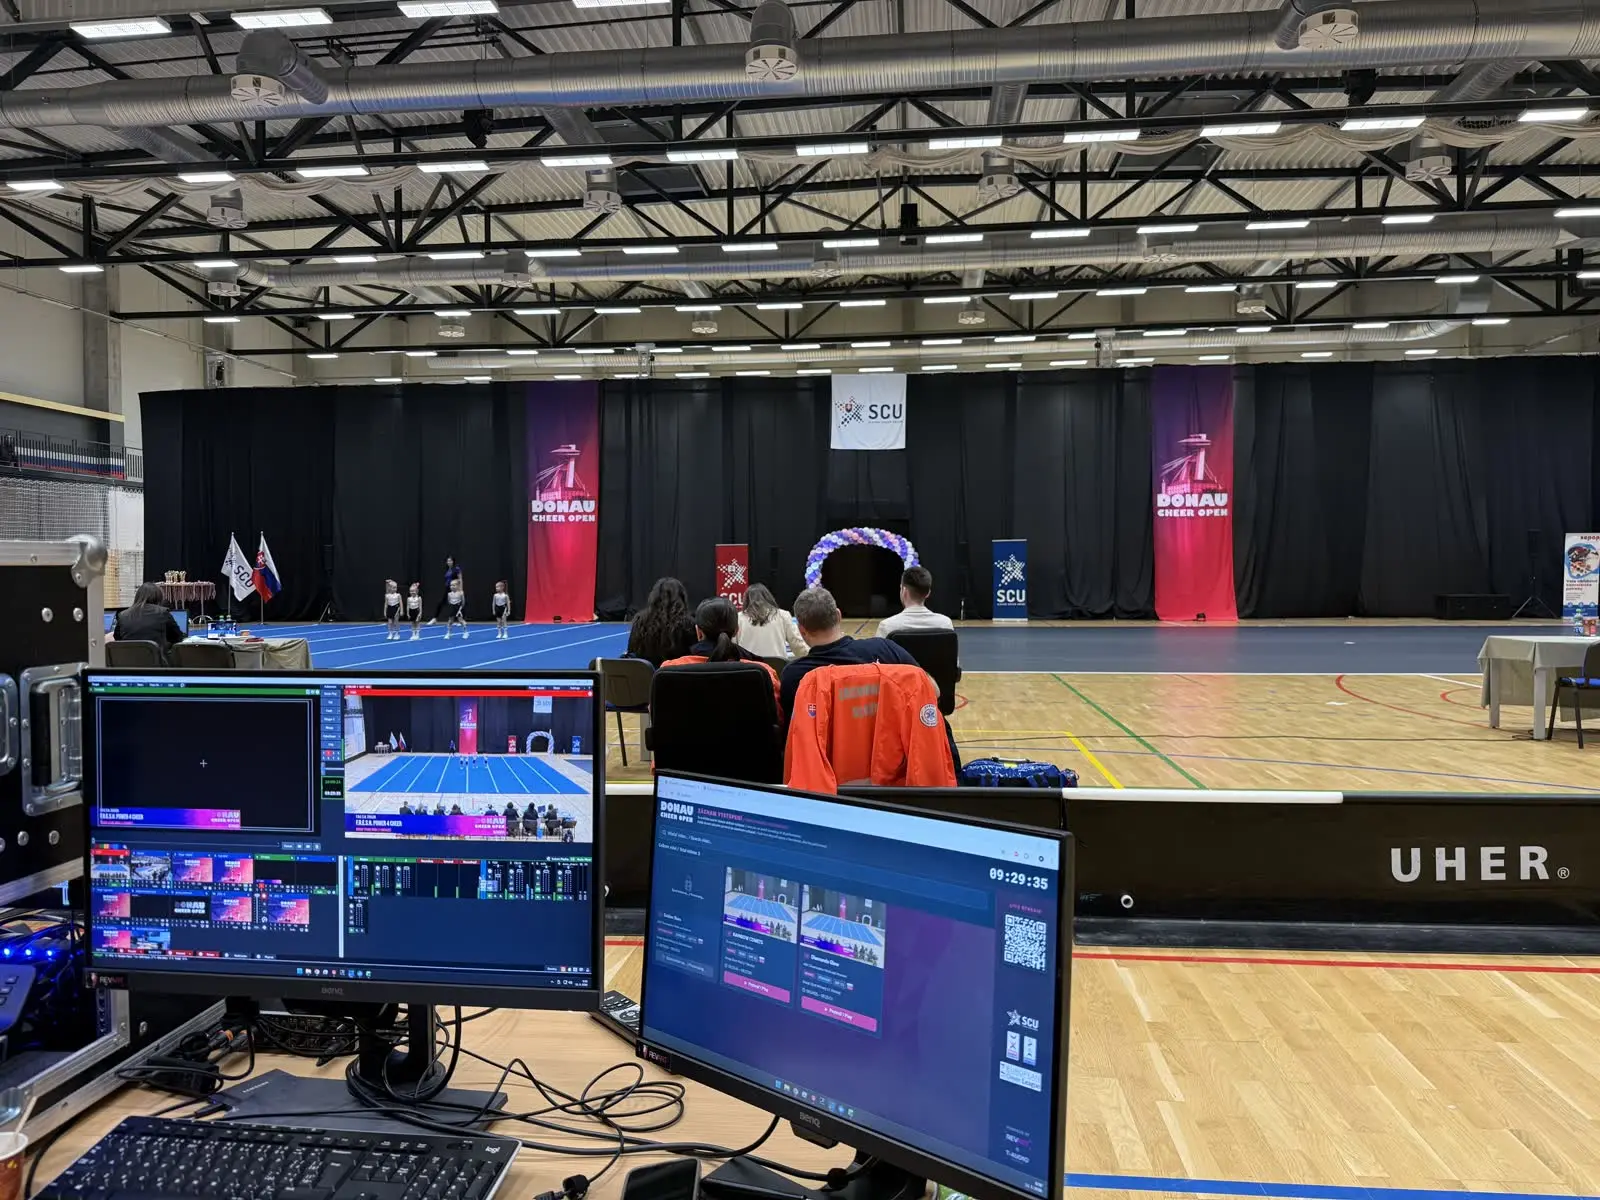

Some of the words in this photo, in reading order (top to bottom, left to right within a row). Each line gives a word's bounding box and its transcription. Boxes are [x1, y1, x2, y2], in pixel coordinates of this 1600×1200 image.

[868, 403, 902, 419] SCU
[531, 500, 595, 513] DONAU
[1157, 493, 1228, 507] DONAU
[532, 514, 565, 522] CHEER
[568, 514, 595, 522] OPEN
[1157, 509, 1194, 517] CHEER
[1198, 509, 1228, 517] OPEN
[234, 565, 254, 588] SCU
[996, 589, 1026, 603] SCU
[660, 801, 694, 816] DONAU
[989, 867, 1048, 890] 09:29:35
[1022, 1016, 1039, 1029] SCU
[485, 1145, 501, 1154] logi
